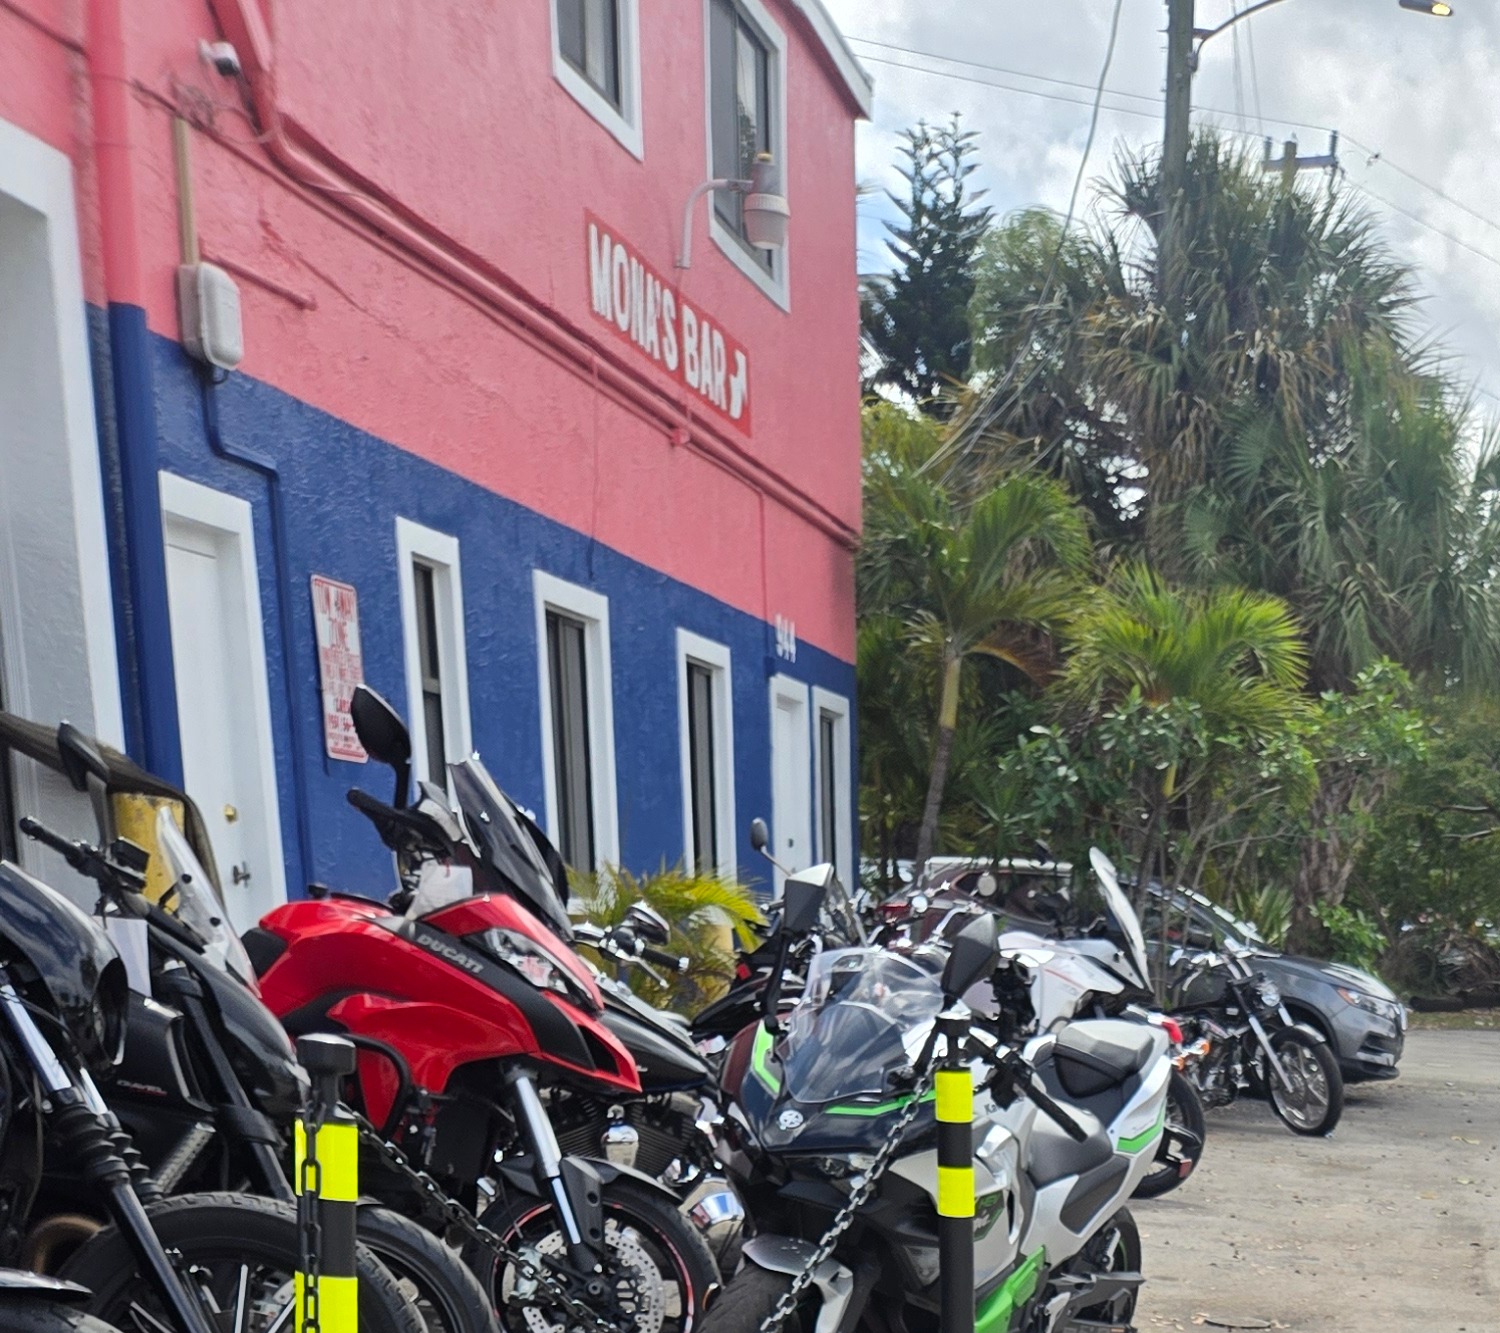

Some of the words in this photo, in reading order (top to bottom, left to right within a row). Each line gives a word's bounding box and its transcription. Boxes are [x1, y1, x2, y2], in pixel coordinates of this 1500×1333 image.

[588, 223, 679, 371] MONA'S
[682, 303, 727, 411] BAR
[416, 934, 484, 974] DUCATI
